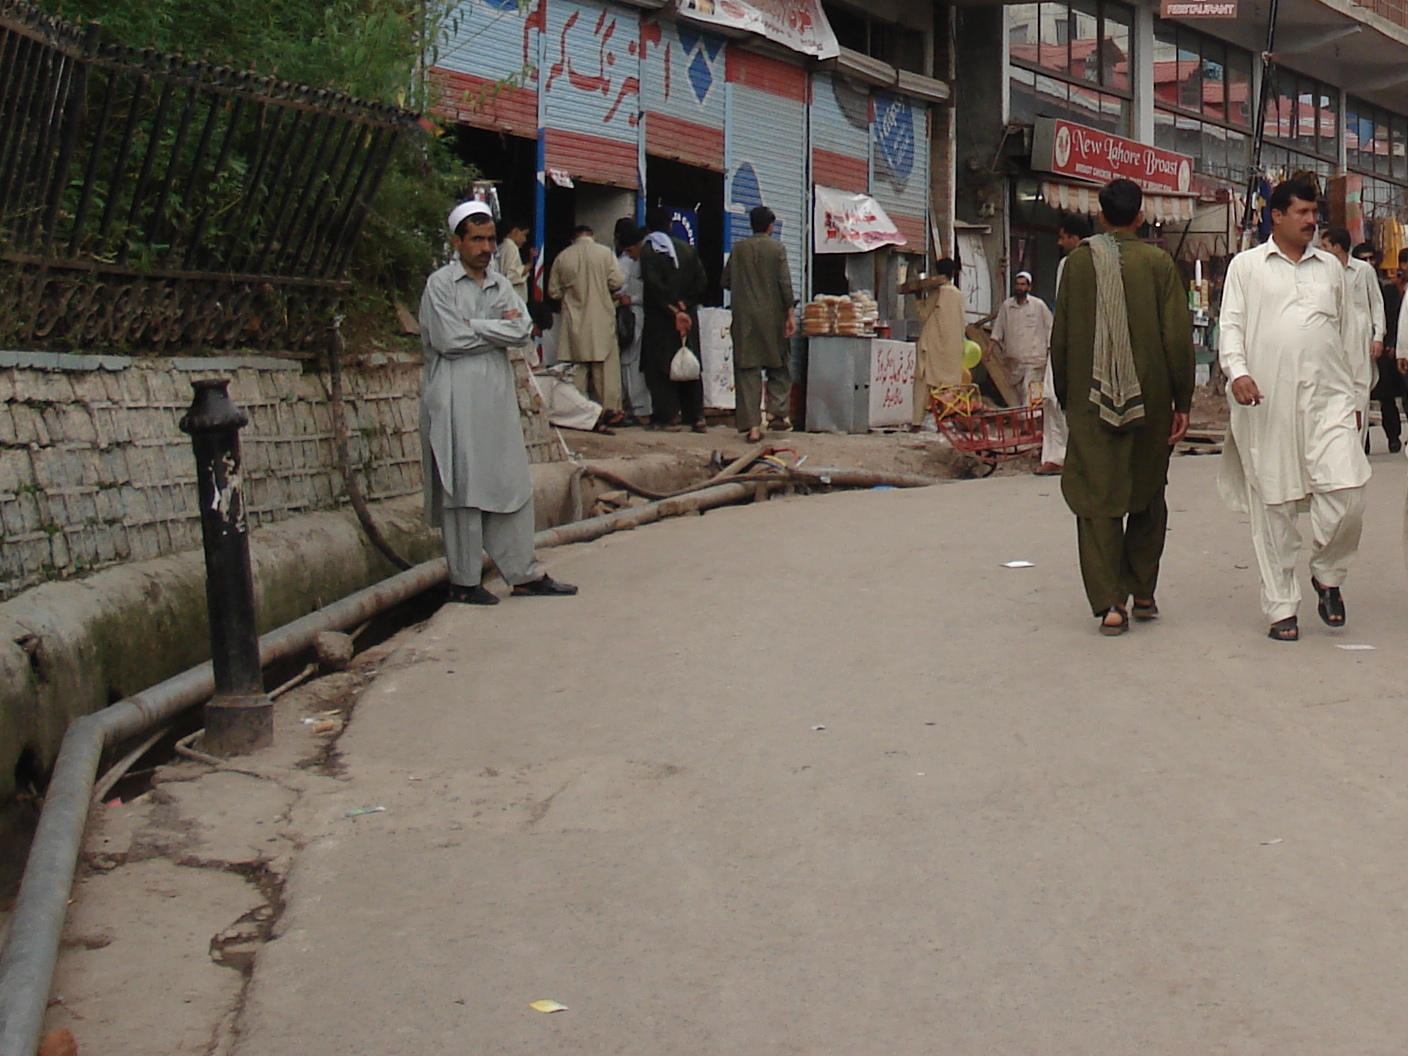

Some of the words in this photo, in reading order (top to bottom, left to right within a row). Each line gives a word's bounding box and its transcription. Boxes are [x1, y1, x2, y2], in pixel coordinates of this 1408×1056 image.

[1167, 4, 1234, 15] RESTAURANT
[1072, 129, 1102, 159] New
[1104, 138, 1141, 169] Lahore
[1143, 149, 1178, 175] Broast
